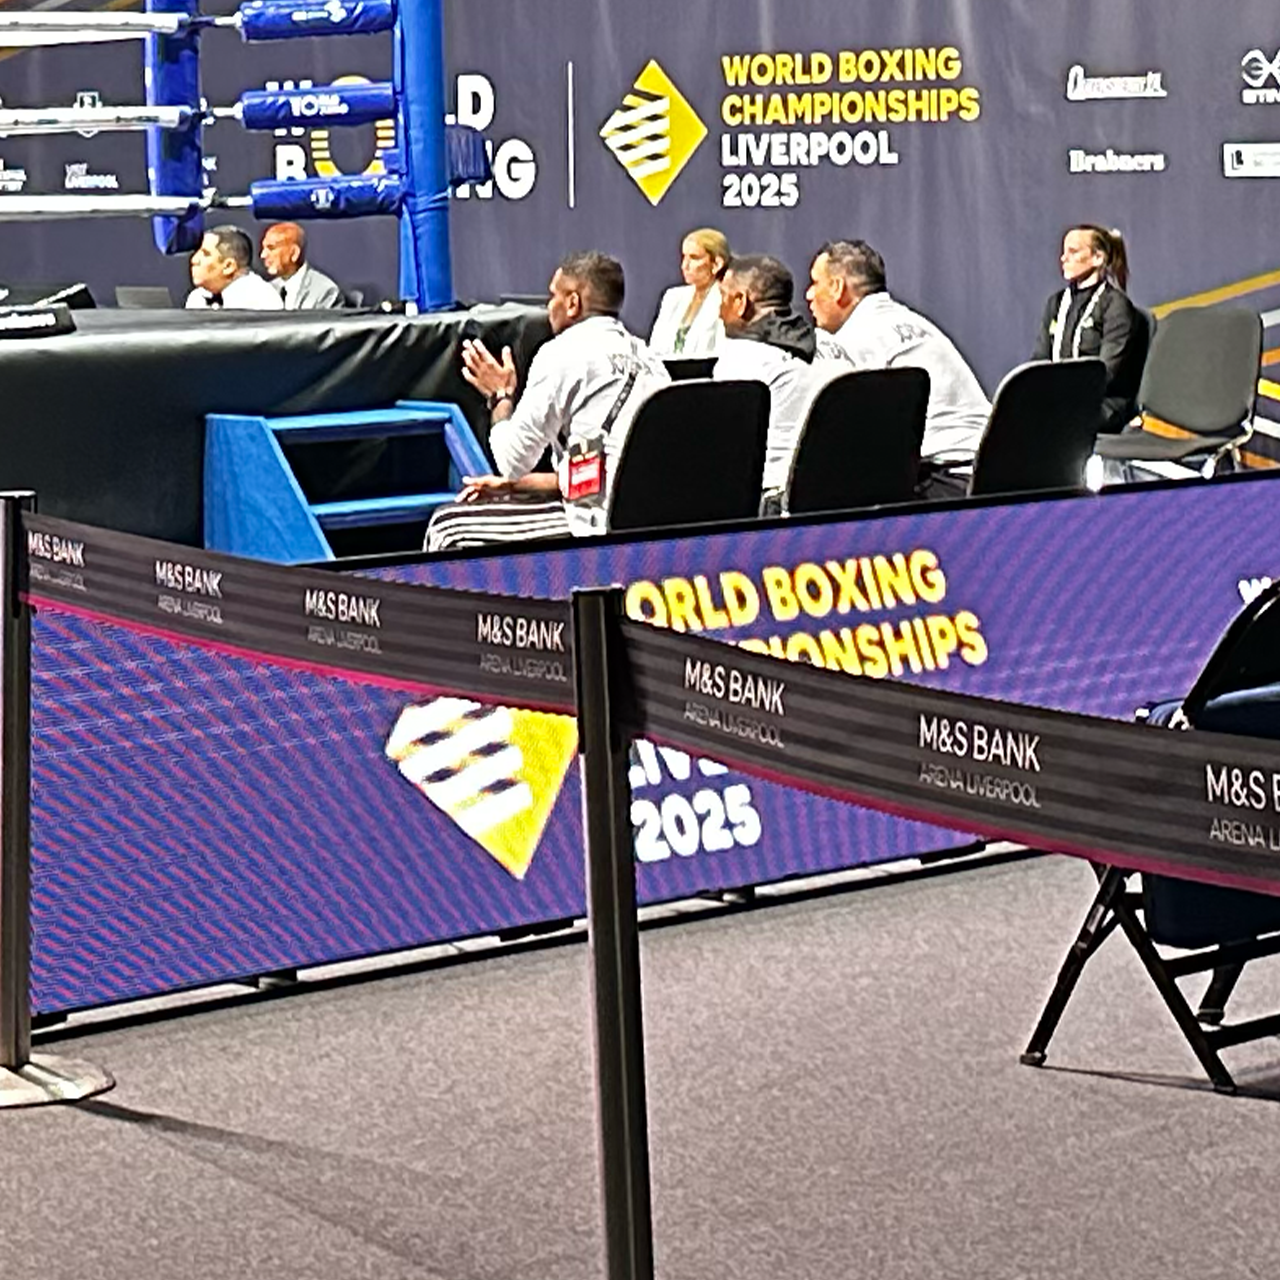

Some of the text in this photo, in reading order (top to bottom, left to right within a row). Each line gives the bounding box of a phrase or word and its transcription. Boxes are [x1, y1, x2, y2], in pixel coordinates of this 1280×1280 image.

[721, 47, 962, 87] WORLD BOXING
[721, 87, 981, 126] CHAMPIONSHIPS
[721, 130, 899, 167] LIVERPOOL
[722, 172, 800, 207] 2025
[28, 530, 85, 567] M&S BANK
[155, 560, 222, 598] M&S BANK
[625, 549, 946, 633] ORLD BOXING
[305, 589, 380, 628] M&S BANK
[477, 614, 565, 652] M&S BANK
[684, 657, 785, 716] M&S BANK
[919, 715, 1040, 771] M&S BANK
[919, 765, 1041, 808] ARENA LIVERPOOL
[1206, 765, 1266, 810] M&S
[630, 784, 761, 863] 2025
[1210, 818, 1264, 846] ARENA
